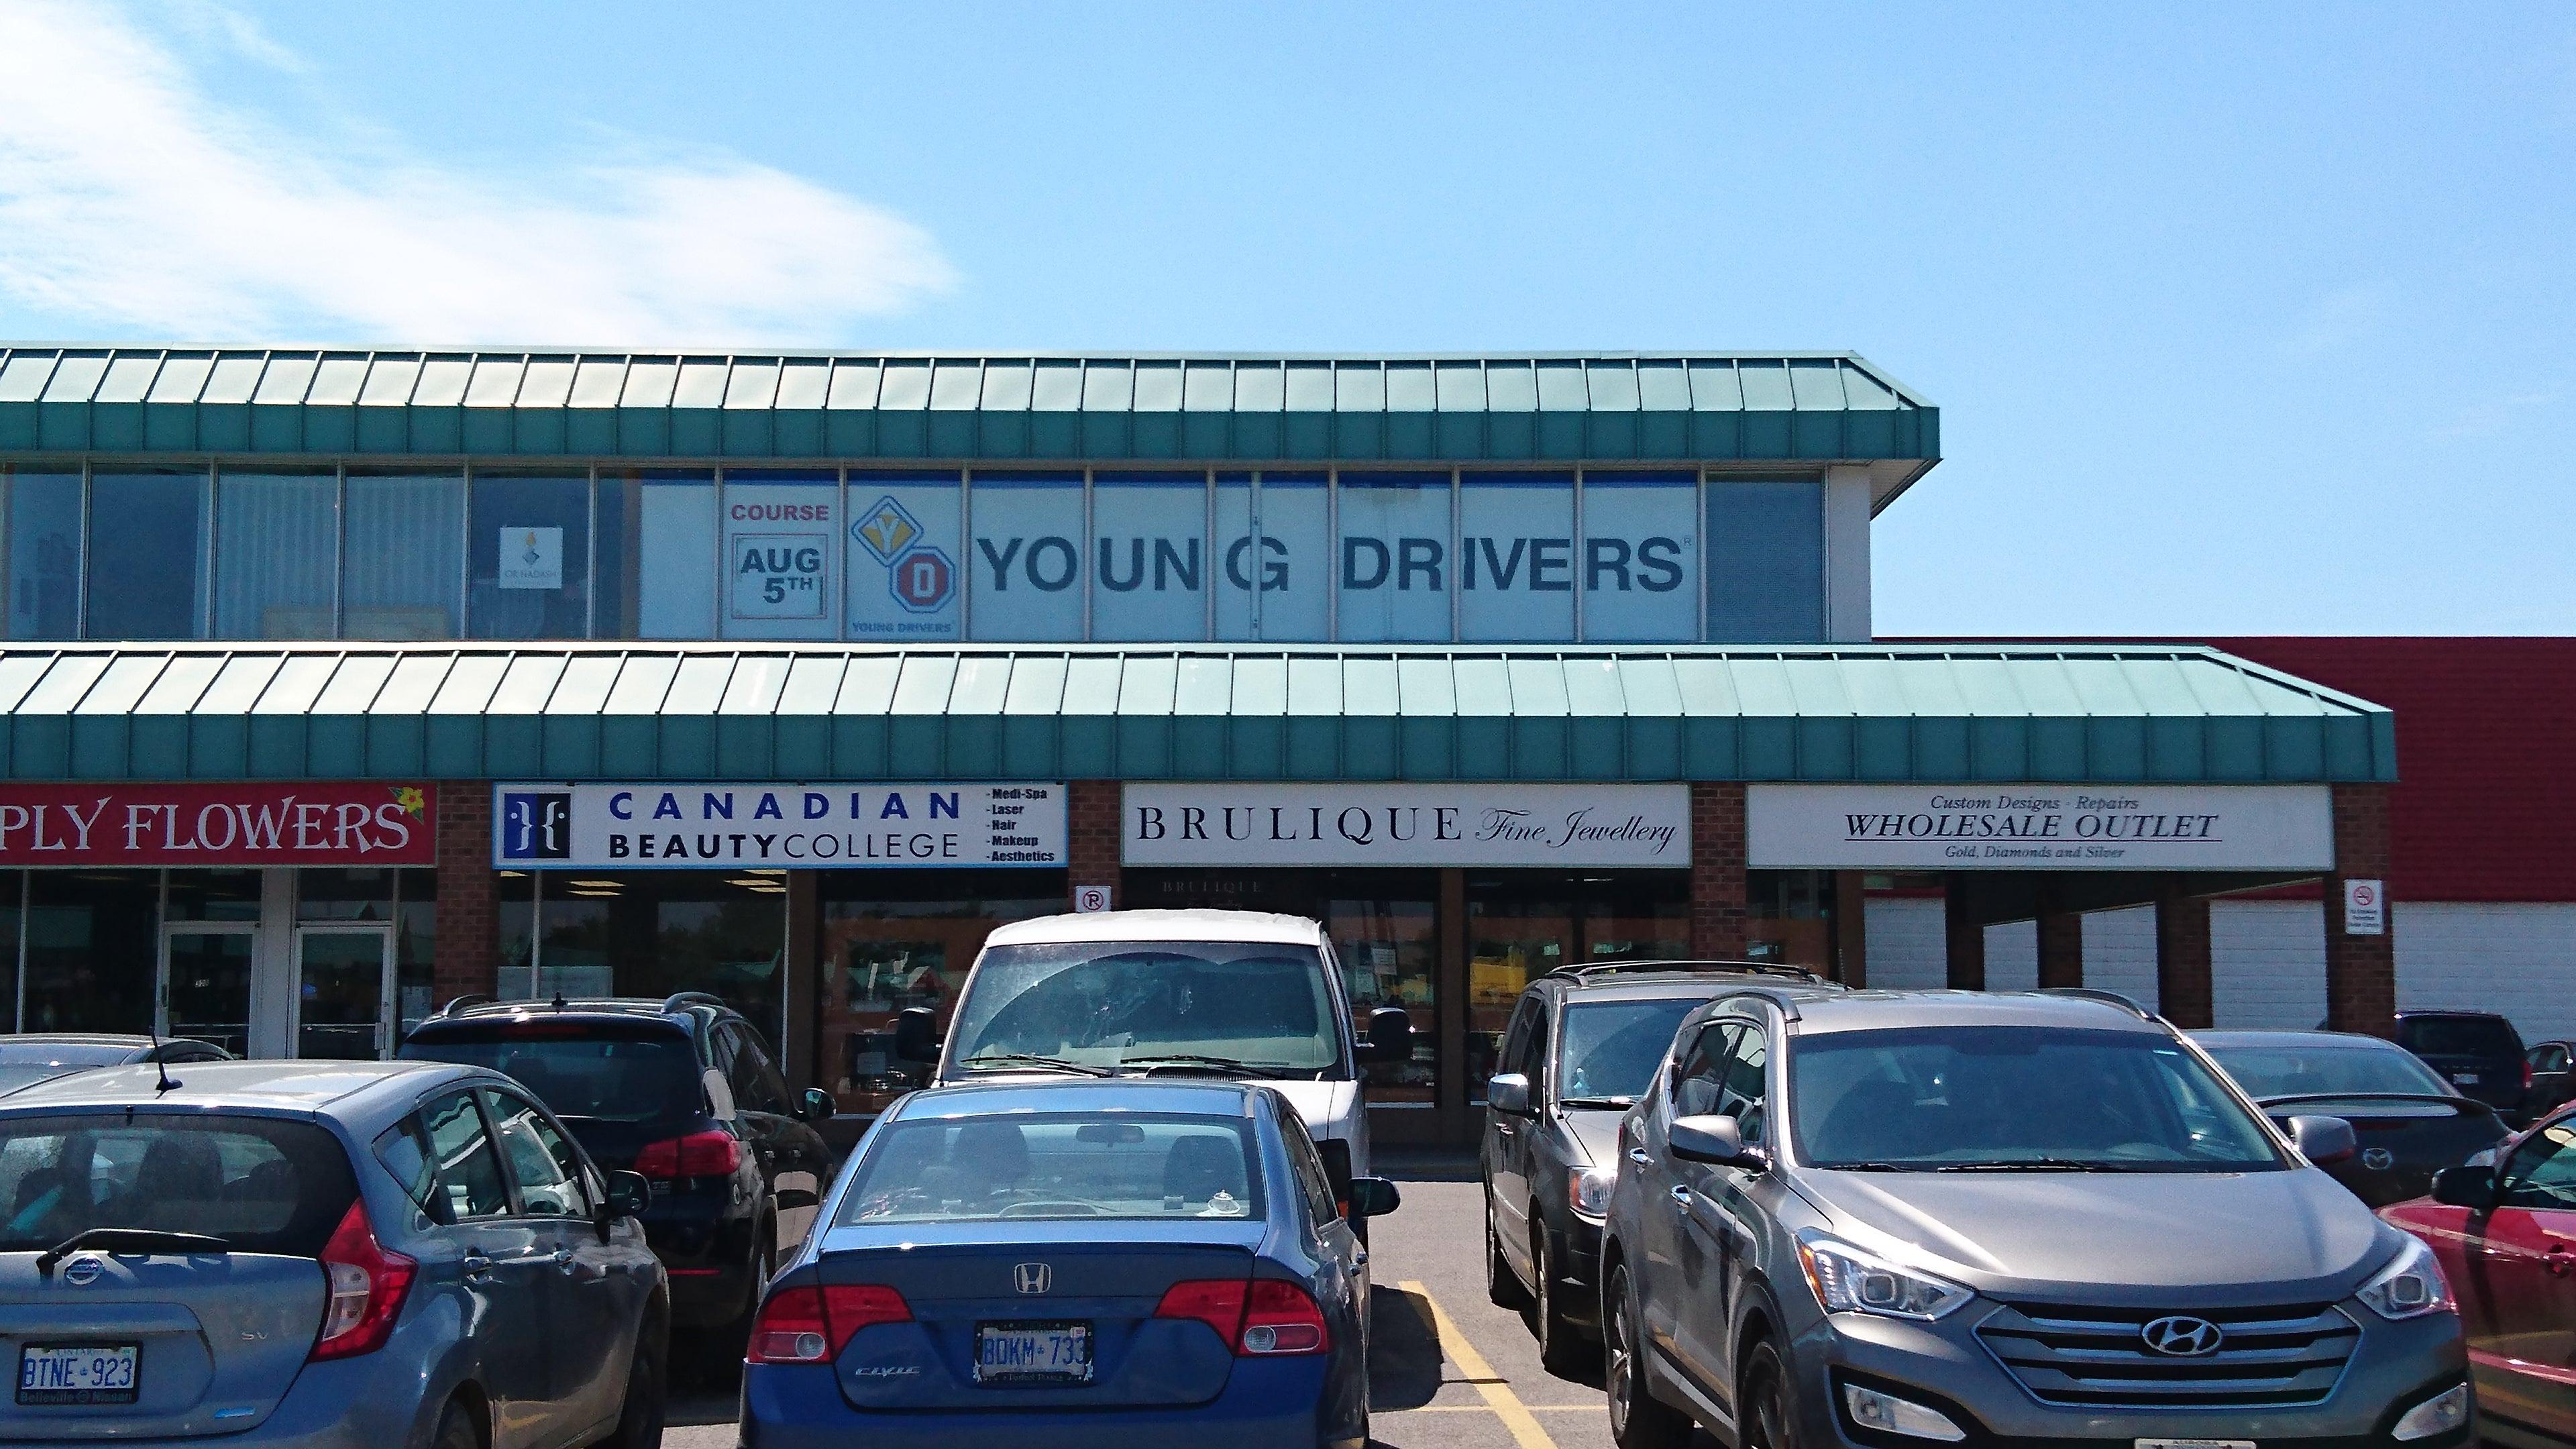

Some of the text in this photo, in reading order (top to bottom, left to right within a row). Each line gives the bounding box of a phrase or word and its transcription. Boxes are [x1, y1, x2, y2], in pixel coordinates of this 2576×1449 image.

[731, 504, 829, 521] COURSE
[740, 547, 820, 574] AUG
[977, 536, 1289, 592] YOUNG
[852, 622, 951, 633] YOUNG DRIVERS
[609, 792, 959, 820] CANADIAN
[1930, 795, 2140, 812] Custom Designs Repairs
[122, 795, 410, 853] FLOWERS
[1136, 806, 1678, 856] BRULIQUE Fine Jewellery
[1844, 814, 2219, 838] WHOLESALE OUTLET
[1984, 845, 2051, 858] Diamonds
[2054, 845, 2082, 858] and
[2085, 845, 2125, 858] Silver
